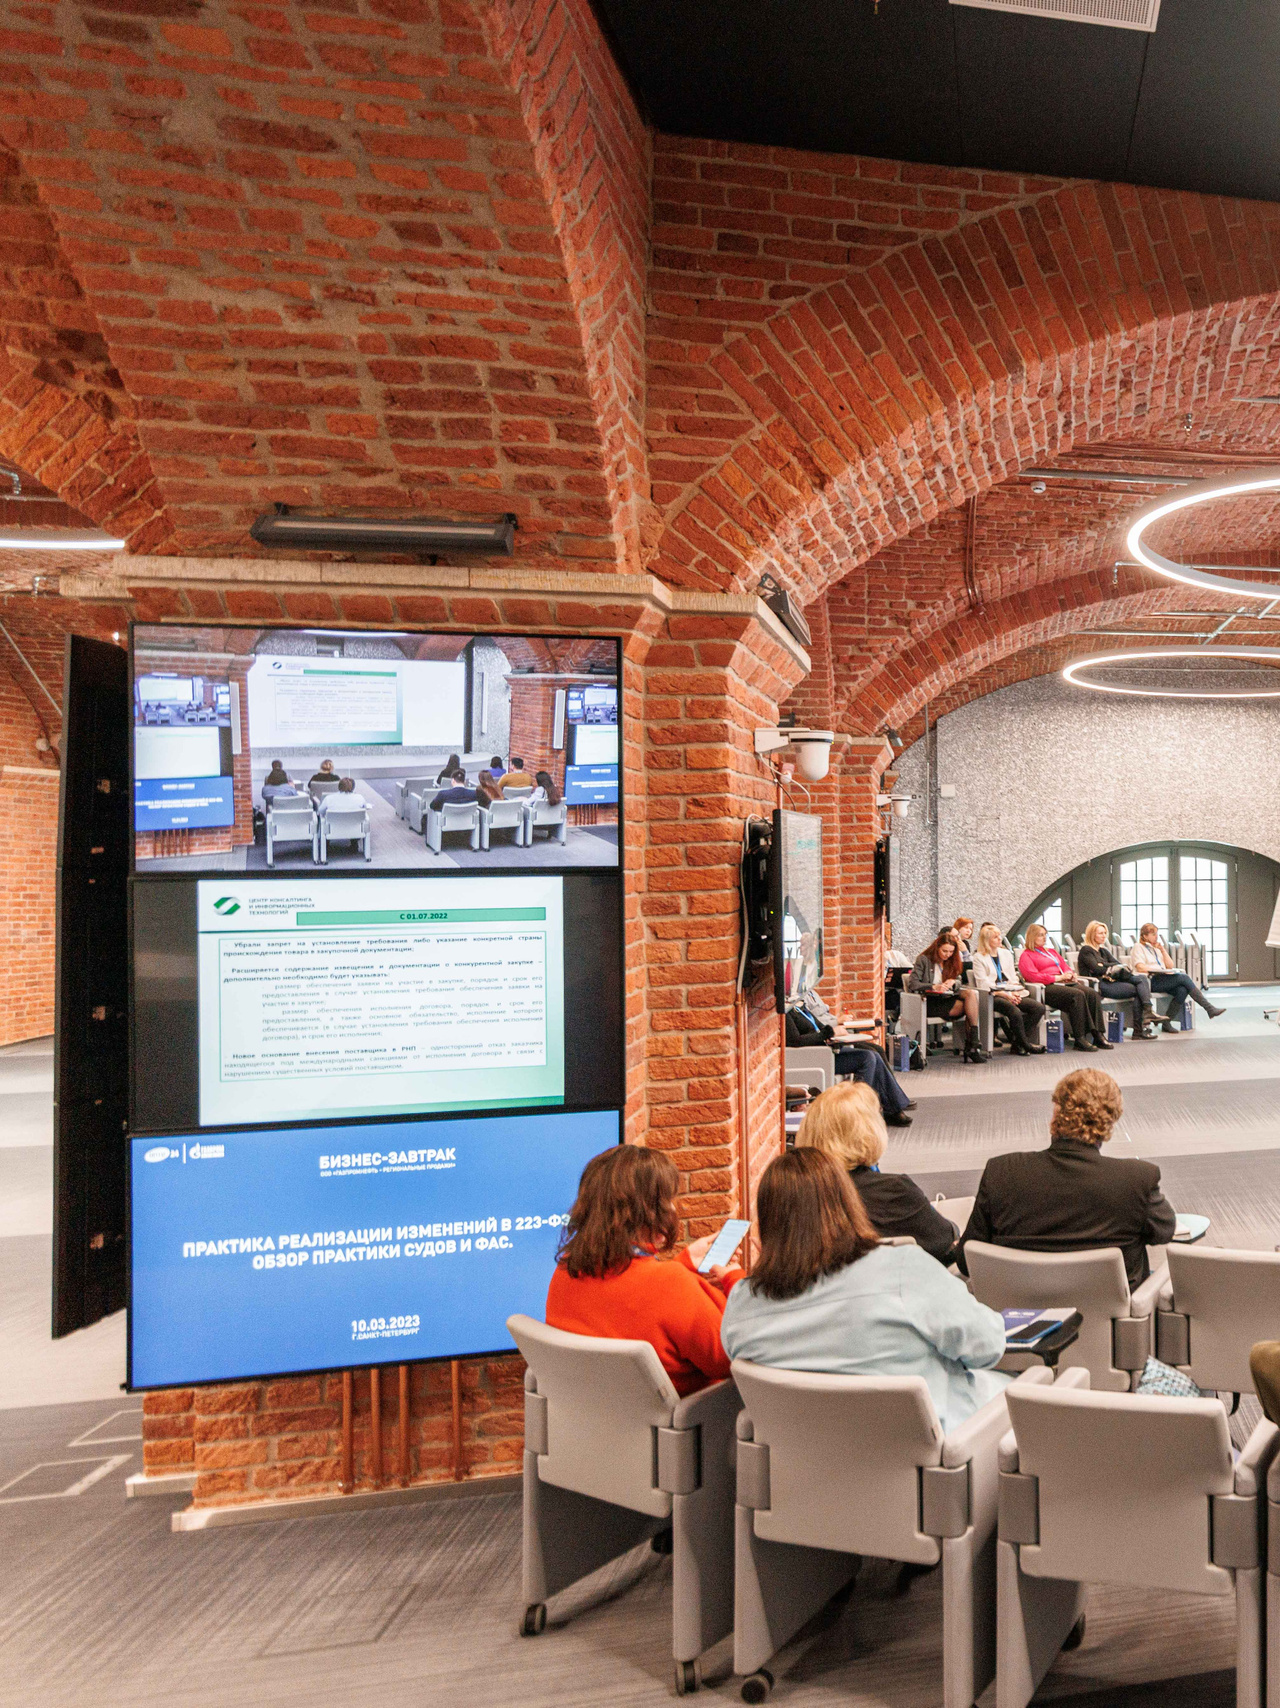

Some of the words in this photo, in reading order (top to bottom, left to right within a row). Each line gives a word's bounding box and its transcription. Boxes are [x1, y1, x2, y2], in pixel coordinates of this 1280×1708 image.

[405, 912, 448, 920] 01.07.2022
[319, 1147, 456, 1169] БИЗНЕС-ЗАВТРАК
[183, 1236, 275, 1258] ПРАКТИКА
[279, 1226, 392, 1250] РЕАЛИЗАЦИИ
[397, 1216, 497, 1240] ИЗМЕНЕНИЙ
[501, 1218, 512, 1232] В
[252, 1252, 309, 1270] ОБЗОР
[313, 1244, 400, 1265] ПРАКТИКИ
[404, 1239, 456, 1258] СУДОВ
[460, 1238, 472, 1252] И
[475, 1235, 514, 1251] ФАС.
[351, 1314, 420, 1333] 10.03.2023
